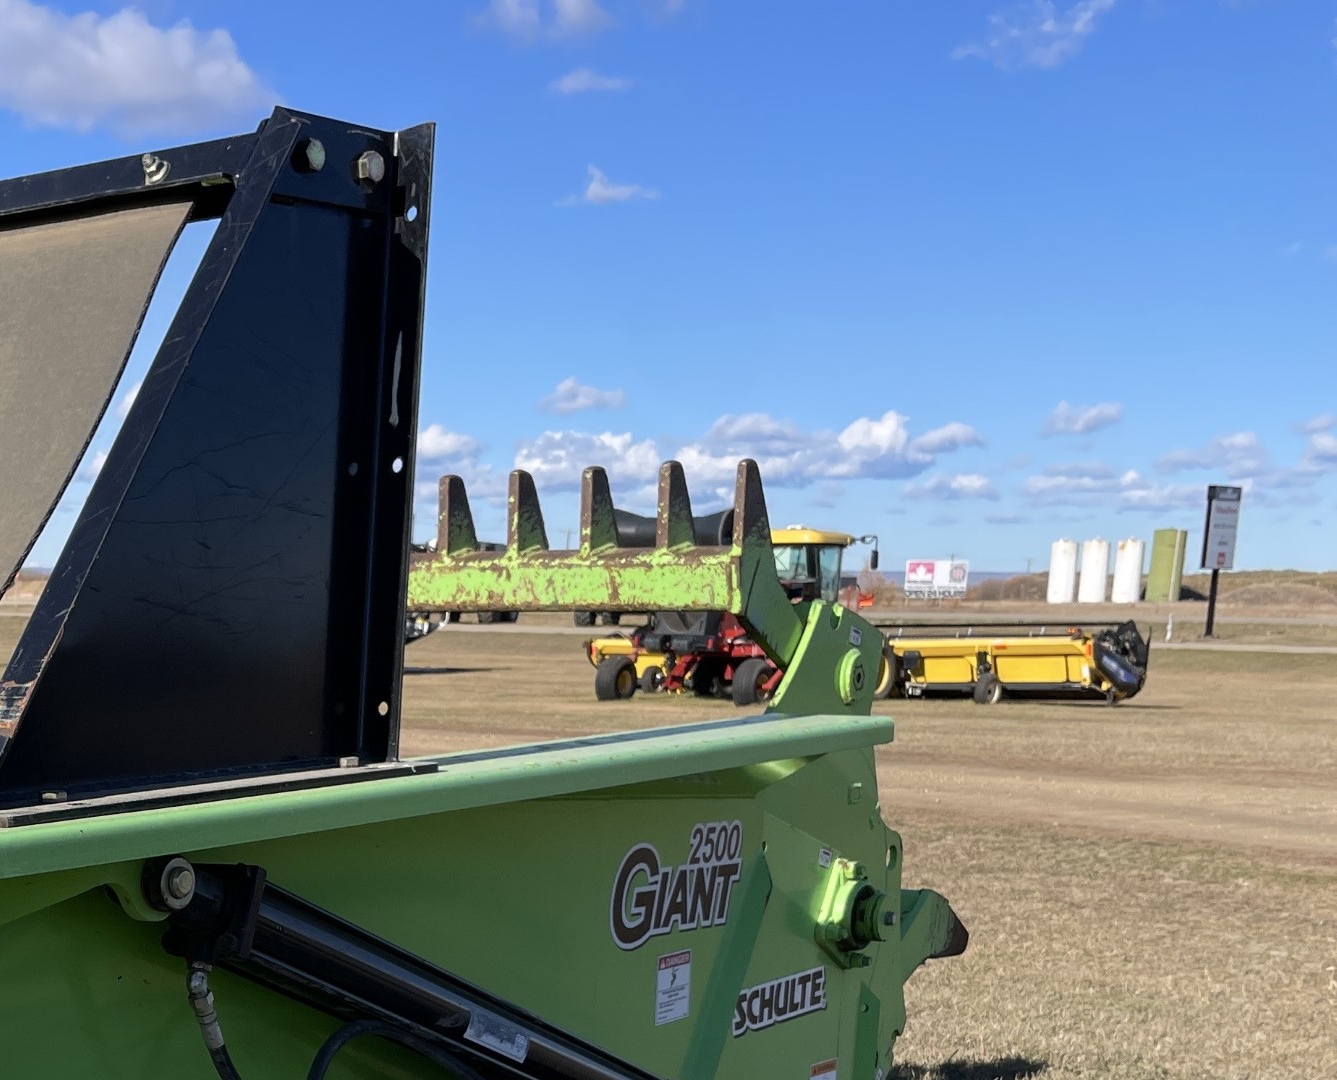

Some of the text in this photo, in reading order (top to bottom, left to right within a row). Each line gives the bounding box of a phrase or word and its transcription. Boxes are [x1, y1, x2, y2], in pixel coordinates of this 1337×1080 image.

[689, 823, 741, 865] 2500
[611, 846, 741, 945] GIANT
[733, 969, 824, 1032] SCHULTE
